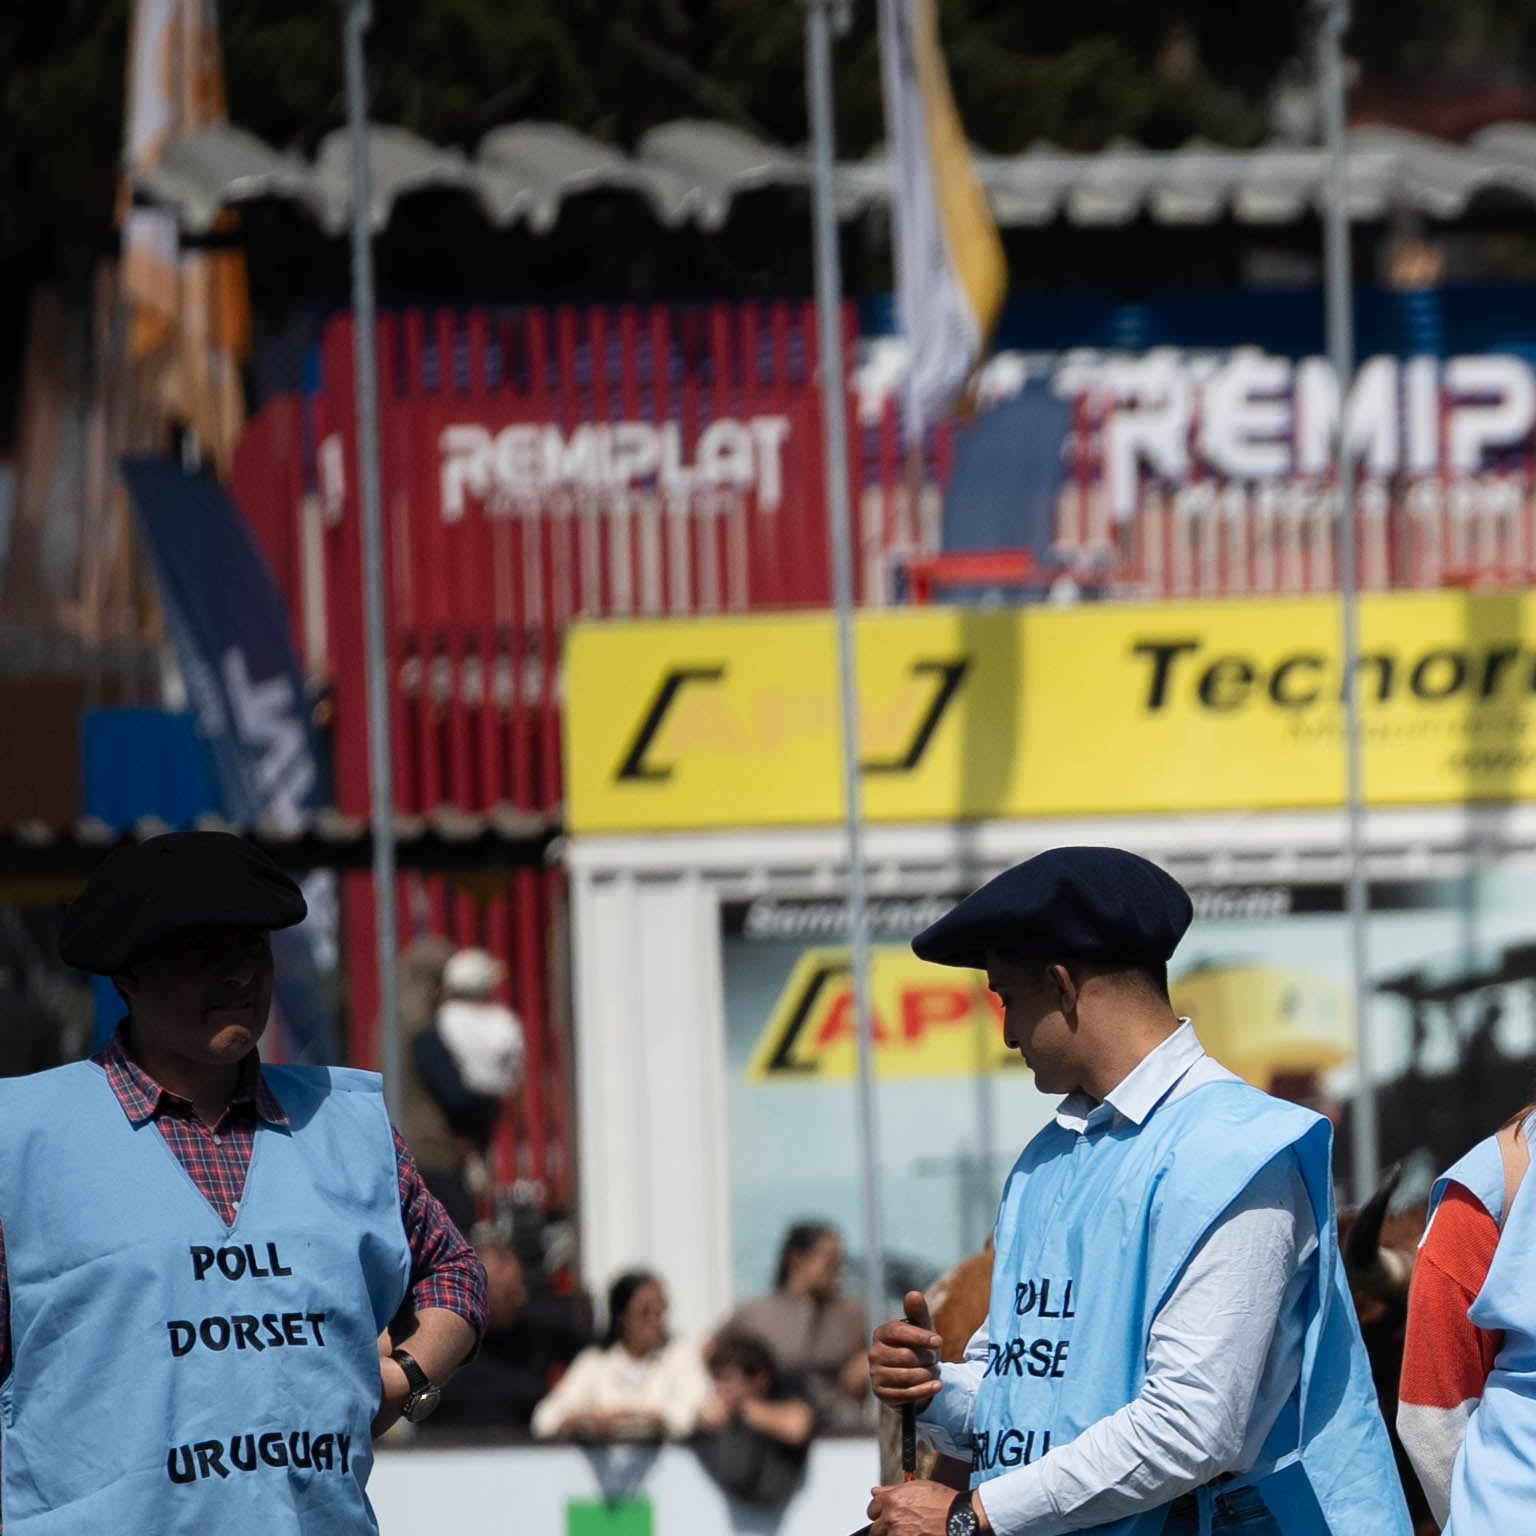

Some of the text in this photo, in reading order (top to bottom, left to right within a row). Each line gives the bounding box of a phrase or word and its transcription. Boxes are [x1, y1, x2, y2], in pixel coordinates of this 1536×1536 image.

[439, 415, 791, 523] REMIPLAT
[190, 1242, 293, 1281] POLL
[167, 1312, 326, 1358] DORSET
[167, 1431, 351, 1485] URUGUAY
